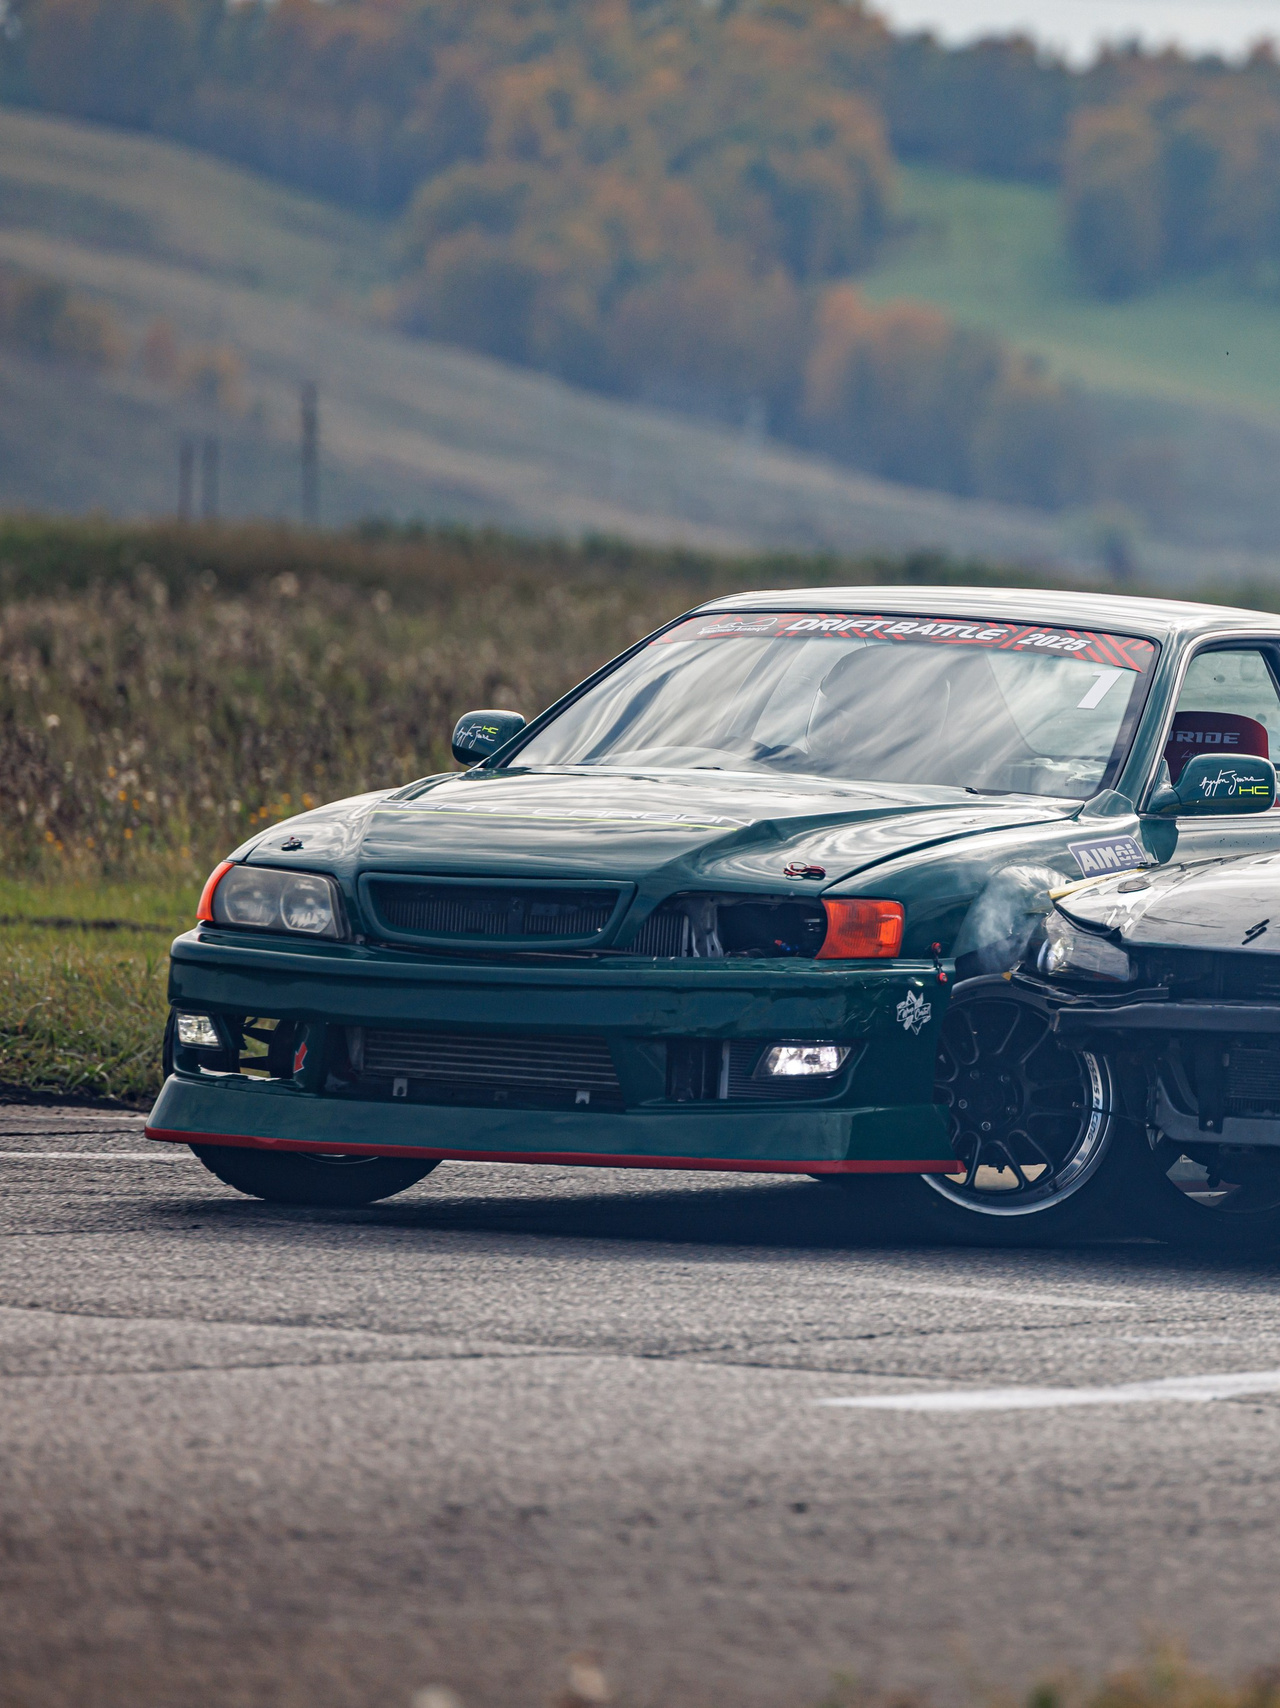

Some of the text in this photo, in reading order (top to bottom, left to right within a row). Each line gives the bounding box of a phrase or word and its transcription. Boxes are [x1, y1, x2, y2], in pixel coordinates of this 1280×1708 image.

[785, 618, 895, 632] DRIFT
[883, 621, 1008, 641] BATTLE
[1017, 633, 1092, 651] 2025
[1076, 670, 1125, 710] 1
[1169, 731, 1241, 744] RIDE
[1239, 786, 1269, 795] HC
[533, 807, 757, 827] CARBON
